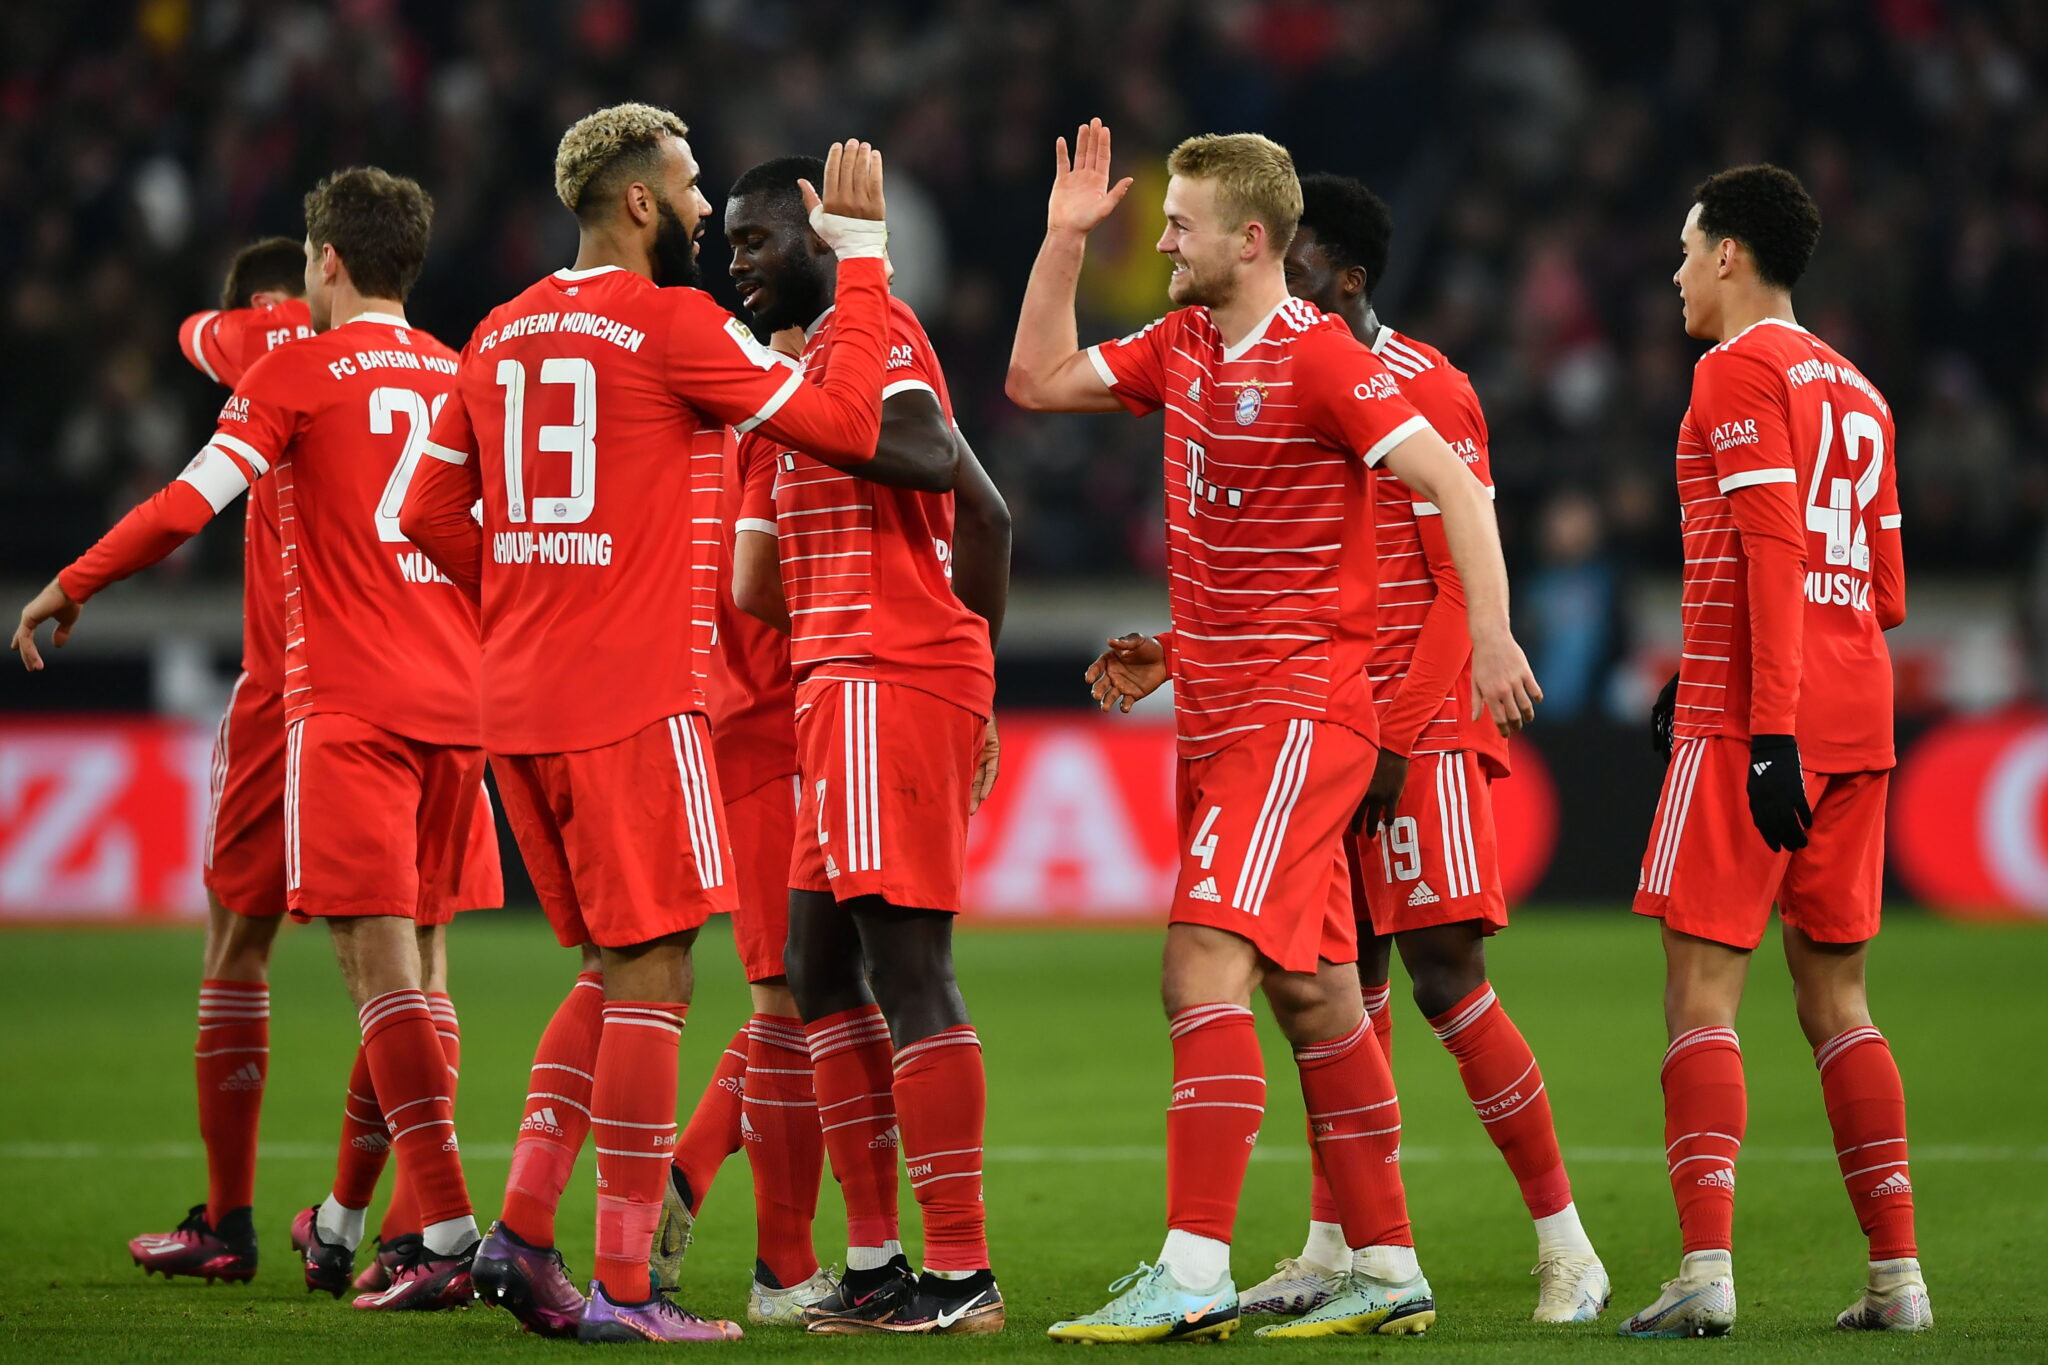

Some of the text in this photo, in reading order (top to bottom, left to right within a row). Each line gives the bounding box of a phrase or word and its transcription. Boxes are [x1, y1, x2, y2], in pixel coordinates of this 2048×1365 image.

[266, 328, 291, 352] FC
[474, 311, 646, 354] FC BAYERN MÜNCHEN
[328, 357, 357, 380] FC
[355, 350, 421, 371] BAYERN
[495, 358, 597, 524] 13
[1715, 433, 1760, 454] AIRWAYS
[1805, 400, 1884, 573] 42
[1190, 805, 1223, 870] 4
[1376, 815, 1422, 884] 19
[1407, 894, 1441, 907] adidas
[519, 1122, 564, 1137] adidas
